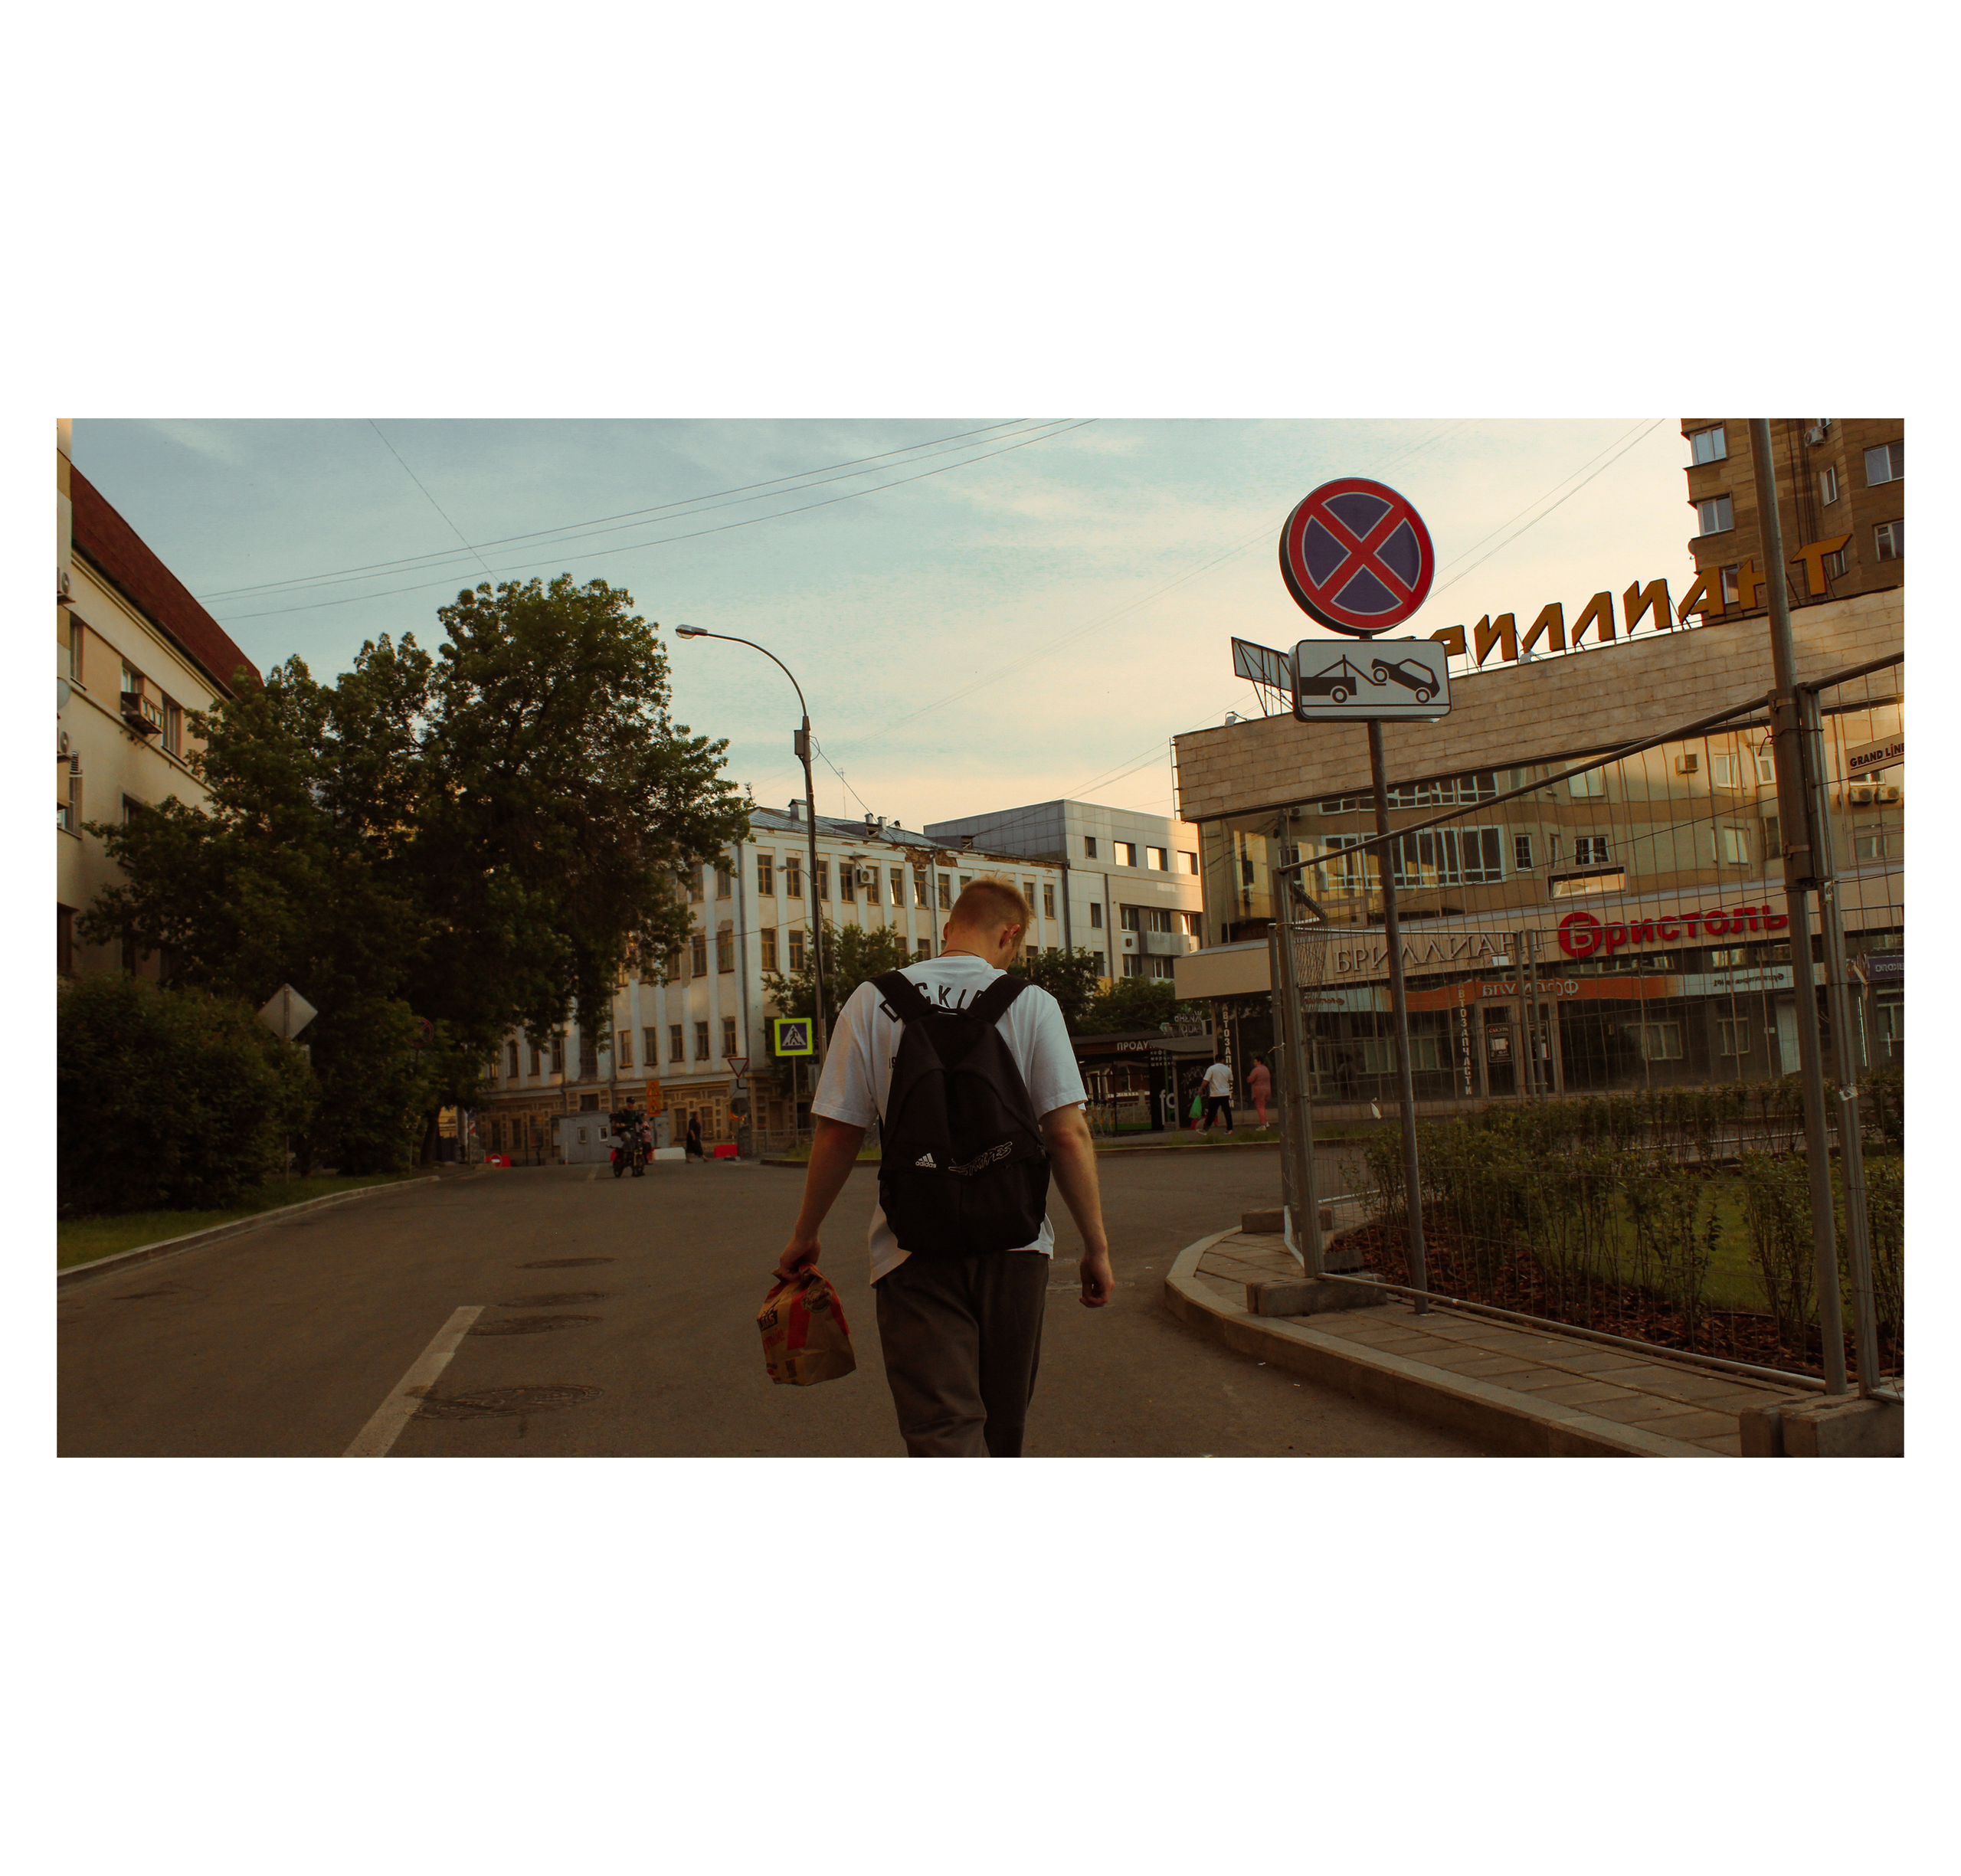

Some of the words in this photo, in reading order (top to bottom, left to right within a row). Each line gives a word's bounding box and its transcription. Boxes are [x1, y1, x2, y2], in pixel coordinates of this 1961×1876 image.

[1850, 750, 1883, 768] GRAND
[1559, 905, 1789, 958] Бристоль
[1458, 980, 1472, 1095] АВТОЗАПЧАСТИ
[915, 1161, 937, 1169] adidas
